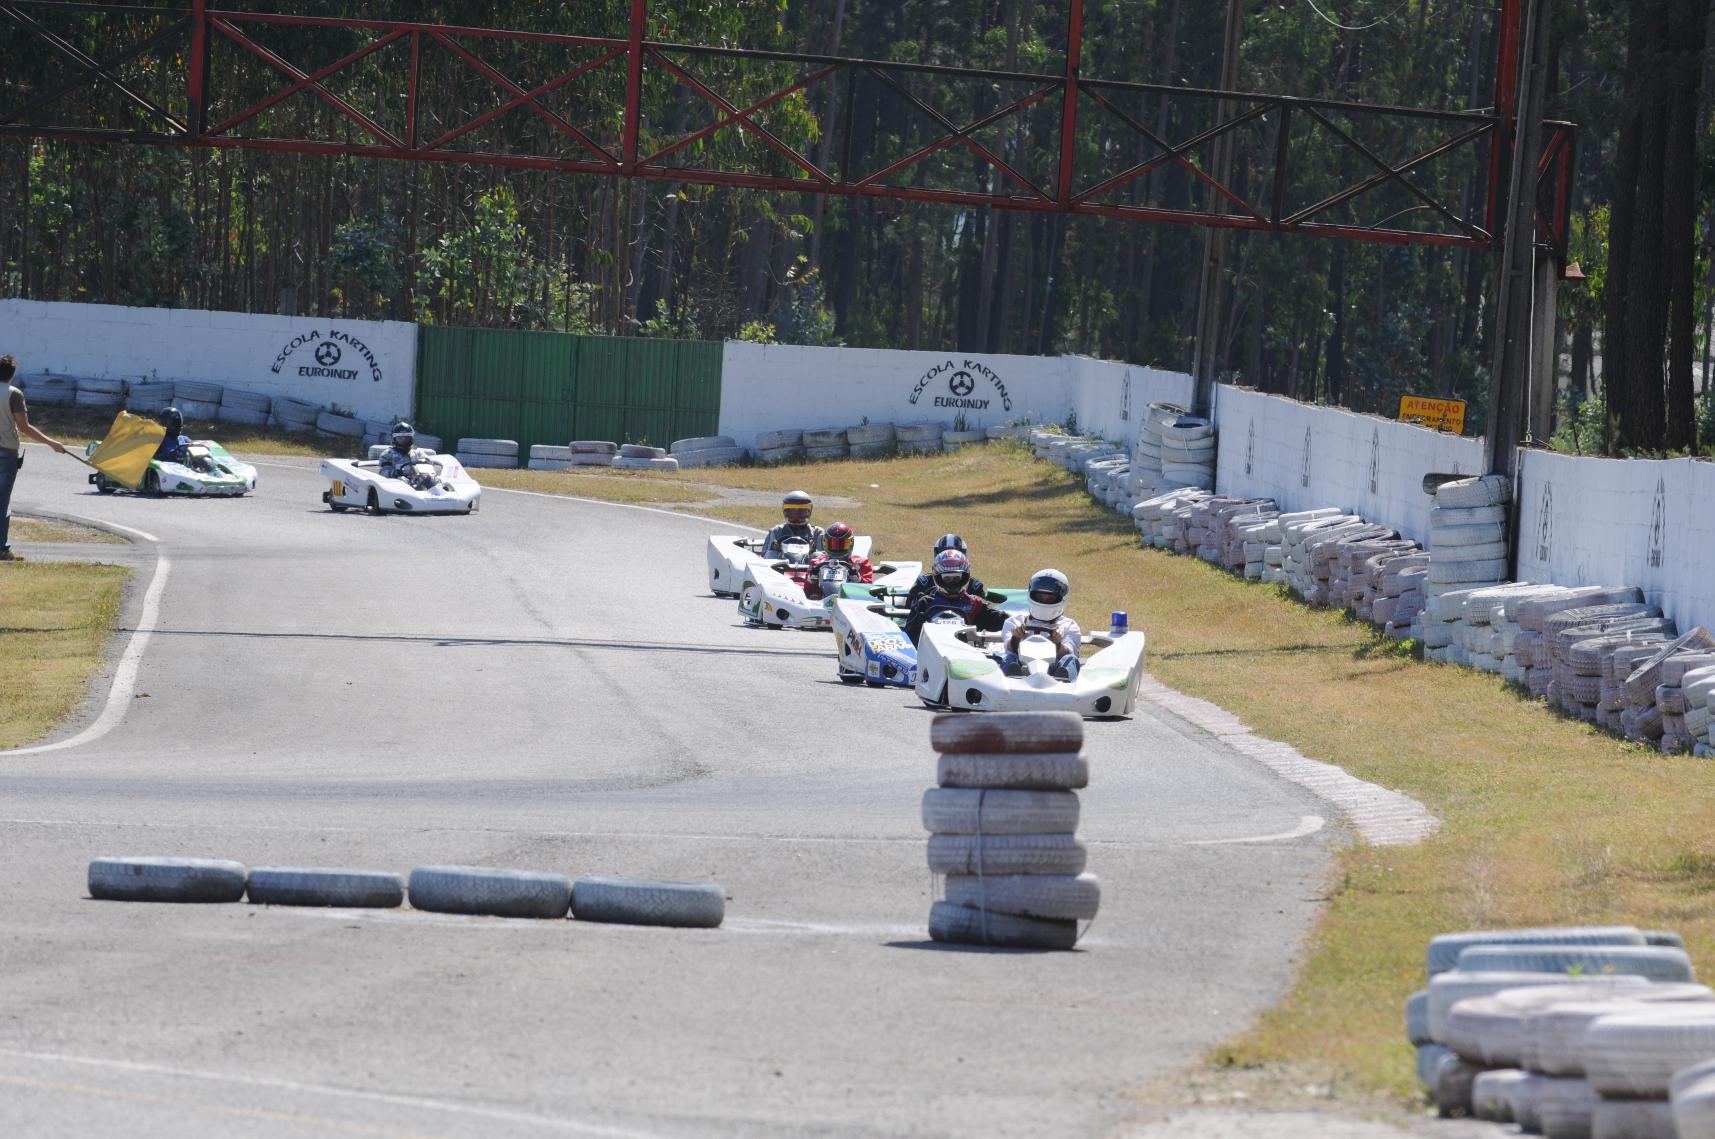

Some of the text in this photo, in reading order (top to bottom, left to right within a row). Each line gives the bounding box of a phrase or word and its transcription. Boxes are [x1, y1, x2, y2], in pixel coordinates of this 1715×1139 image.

[271, 330, 383, 382] ESCOLA KARTING
[298, 366, 359, 380] EUROINDY
[909, 360, 1013, 412] ESCOLA KARTING
[934, 396, 990, 410] EUROINDY
